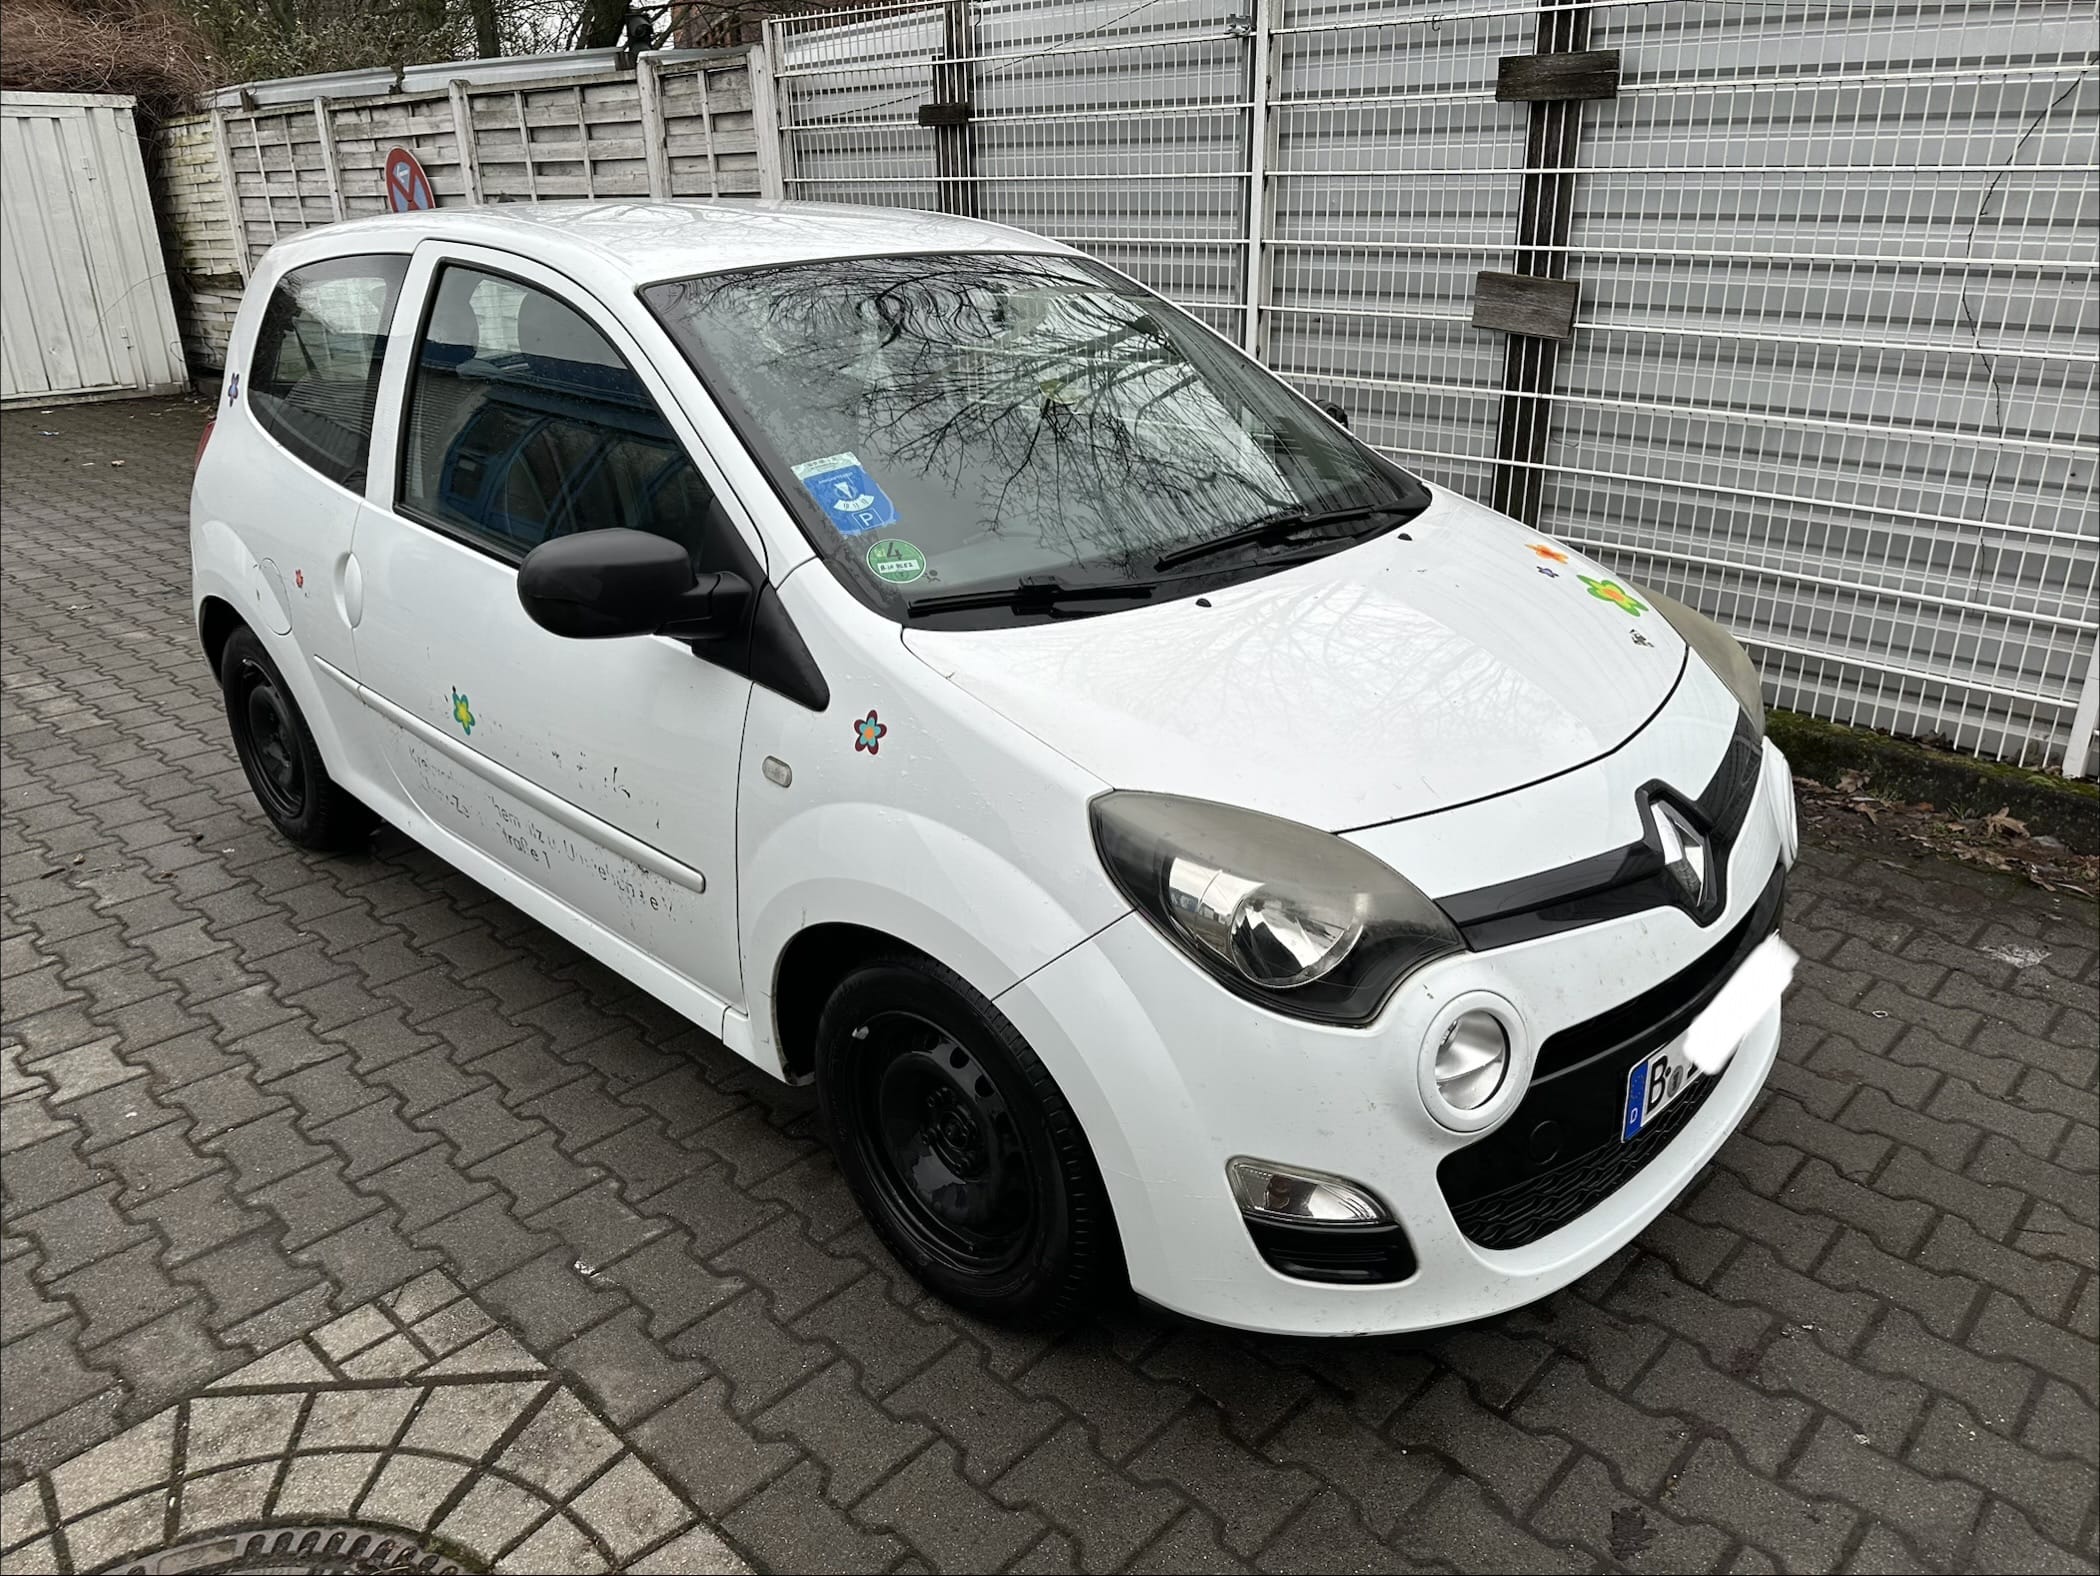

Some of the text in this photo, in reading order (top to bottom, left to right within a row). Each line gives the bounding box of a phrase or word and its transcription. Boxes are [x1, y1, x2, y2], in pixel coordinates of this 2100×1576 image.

[859, 513, 873, 526] P
[887, 541, 902, 561] 4
[1647, 1056, 1668, 1115] B
[1630, 1107, 1638, 1124] D
